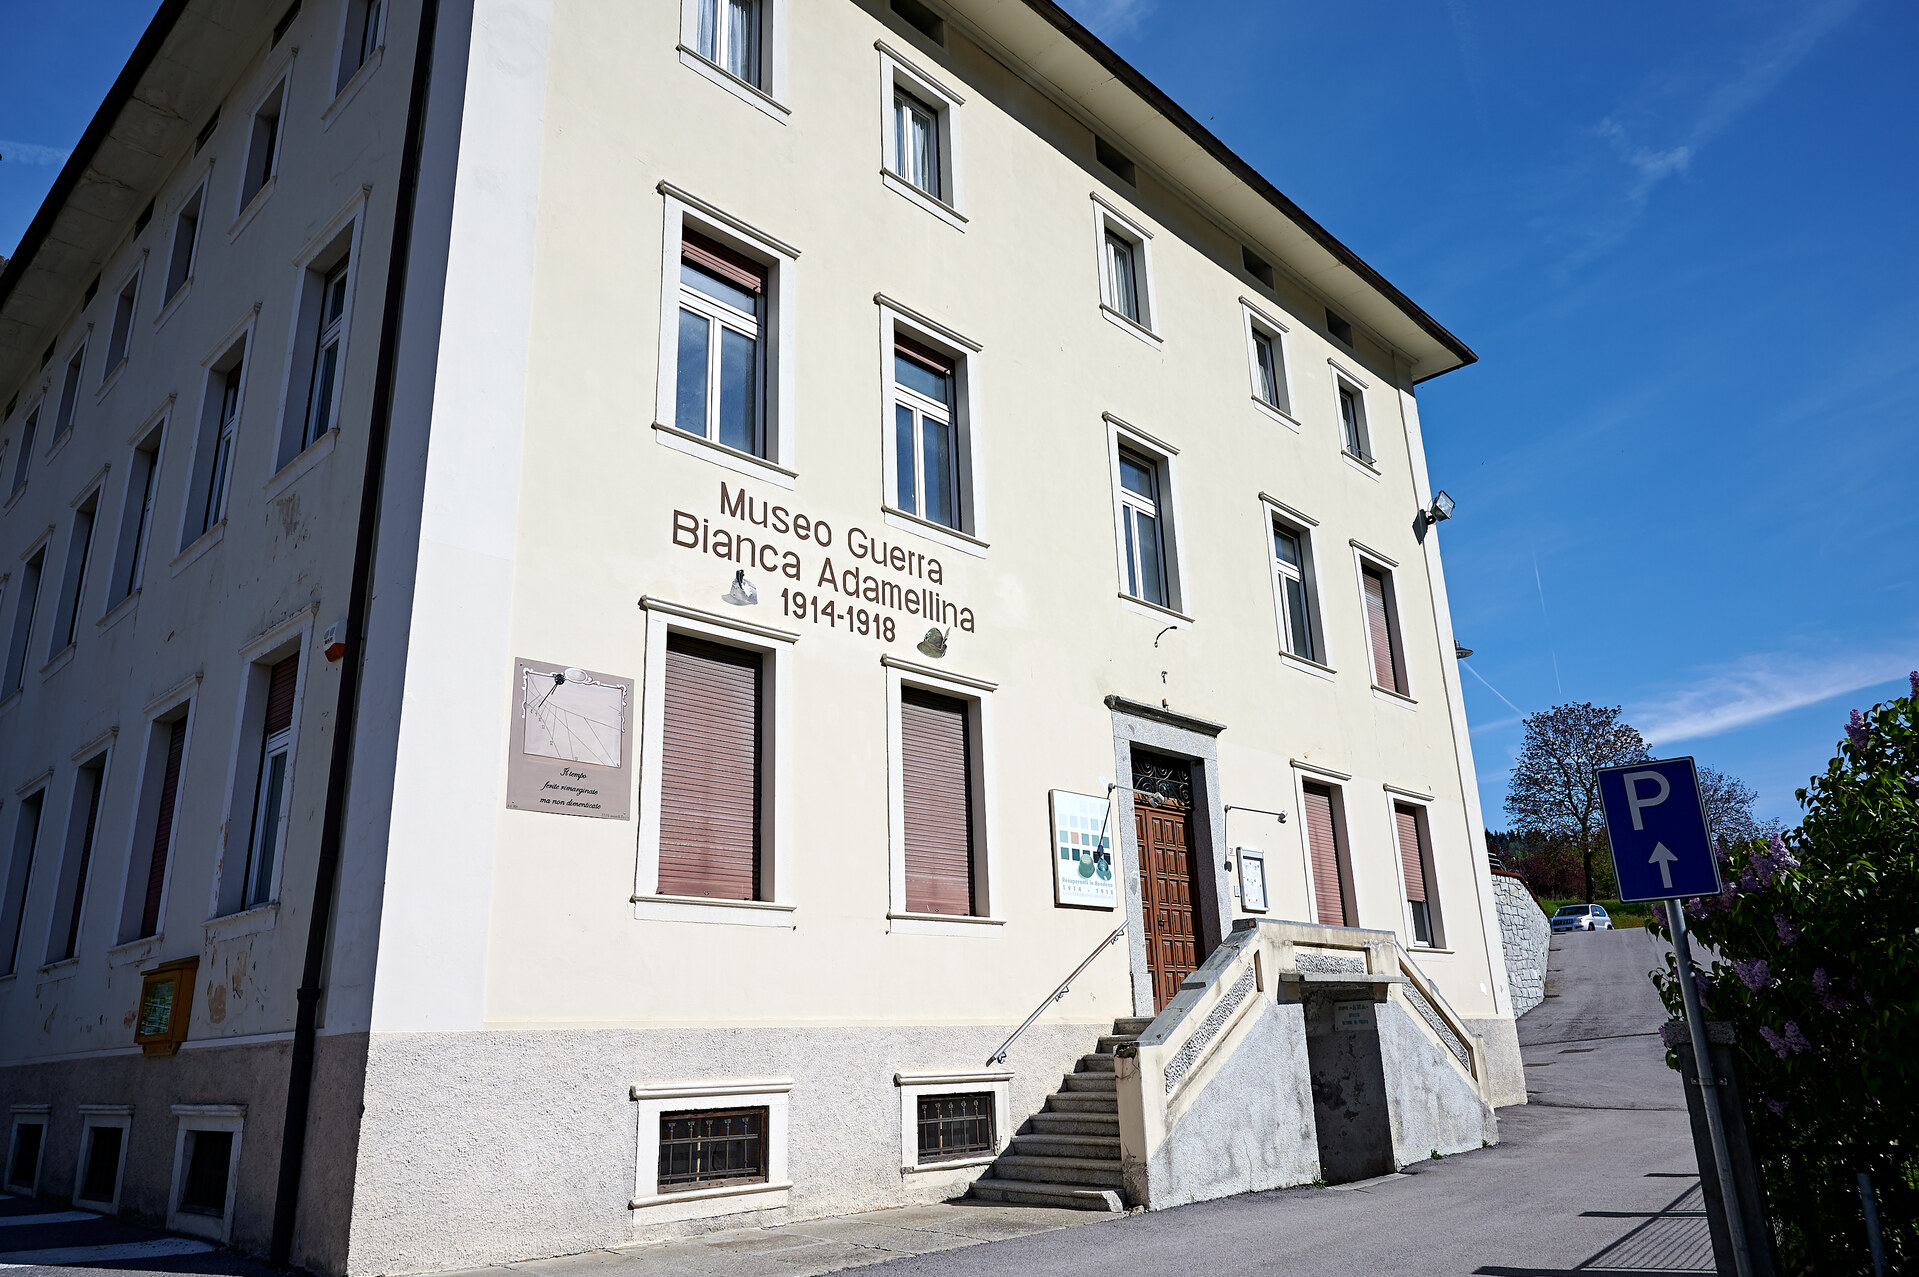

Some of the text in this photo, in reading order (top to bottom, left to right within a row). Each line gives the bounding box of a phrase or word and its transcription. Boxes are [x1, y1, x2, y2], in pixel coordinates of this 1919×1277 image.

[720, 481, 943, 585] Museo Guerra
[672, 509, 975, 633] Bianca Adamellina
[781, 587, 896, 643] 1914-1918
[540, 781, 598, 796] ferite rimarginate
[569, 770, 587, 781] tempo
[1623, 770, 1670, 831] P
[566, 799, 601, 810] dimenticate
